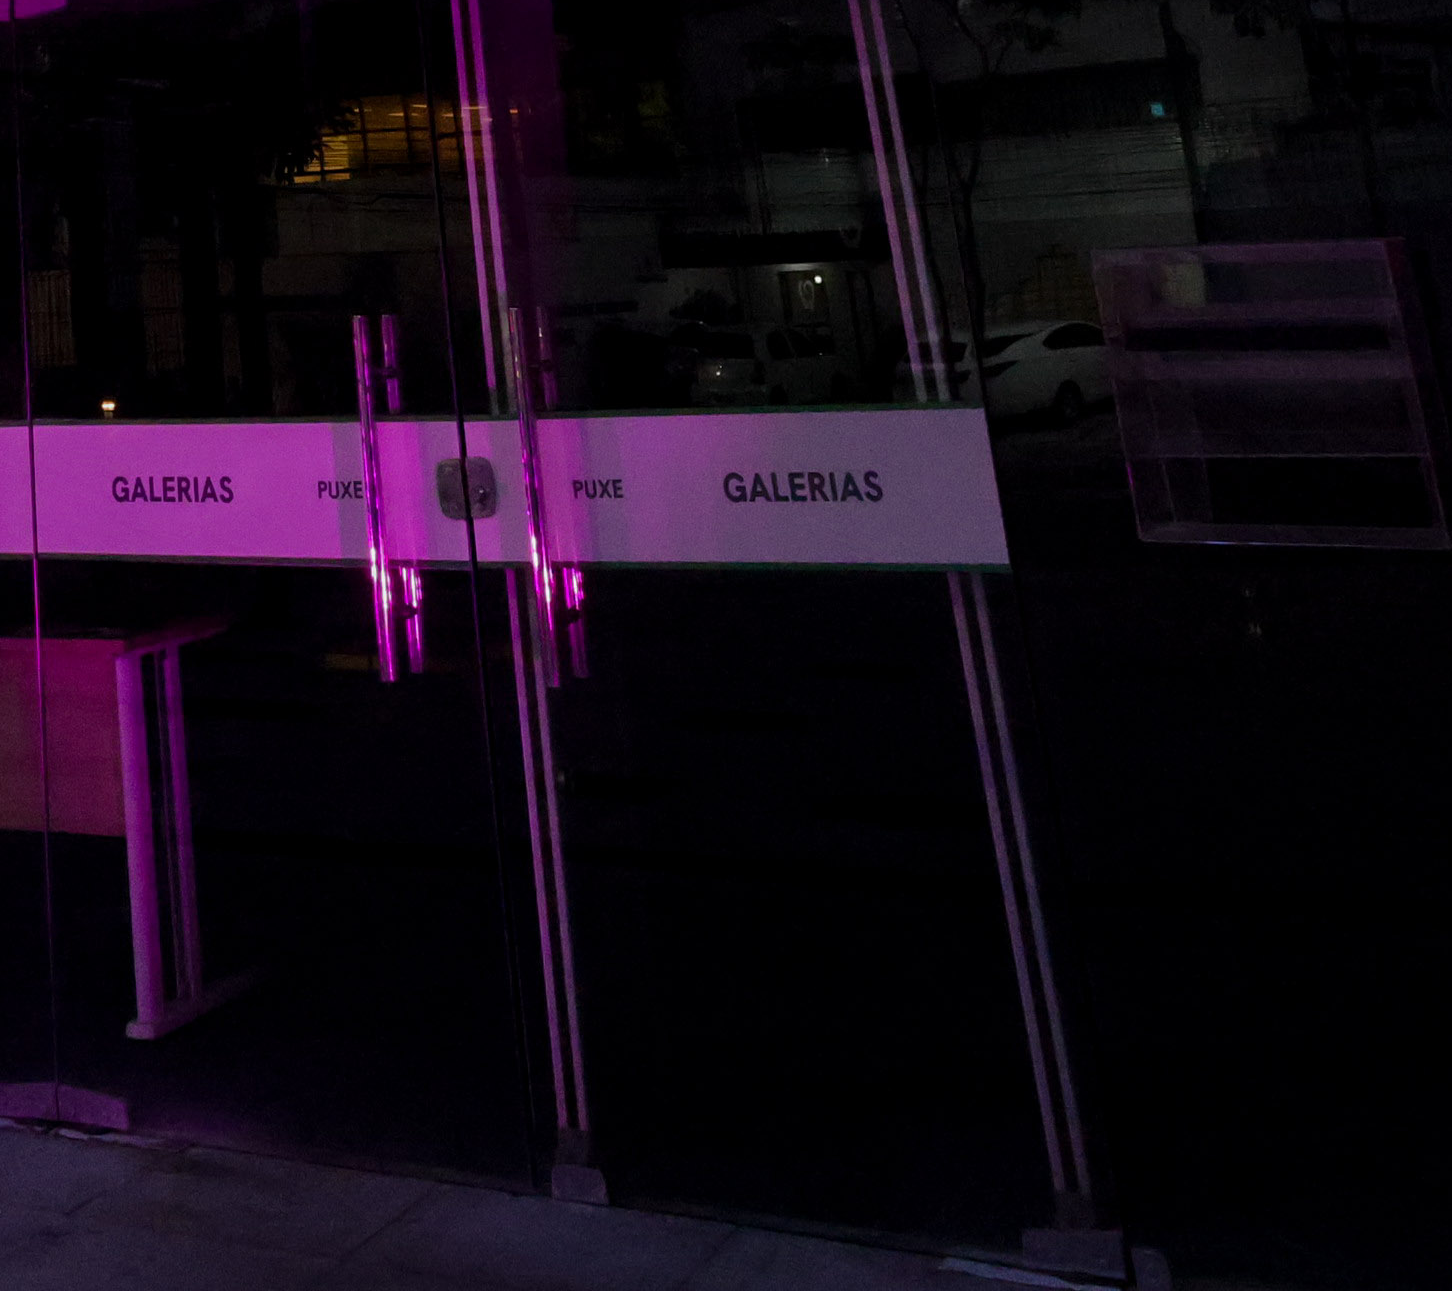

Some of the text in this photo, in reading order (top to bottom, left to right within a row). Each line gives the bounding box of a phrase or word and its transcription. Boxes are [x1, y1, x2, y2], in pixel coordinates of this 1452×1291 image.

[111, 475, 235, 504] GALERIAS
[317, 479, 364, 499] PUXE
[571, 478, 625, 499] PUXE
[722, 470, 884, 503] GALERIAS
